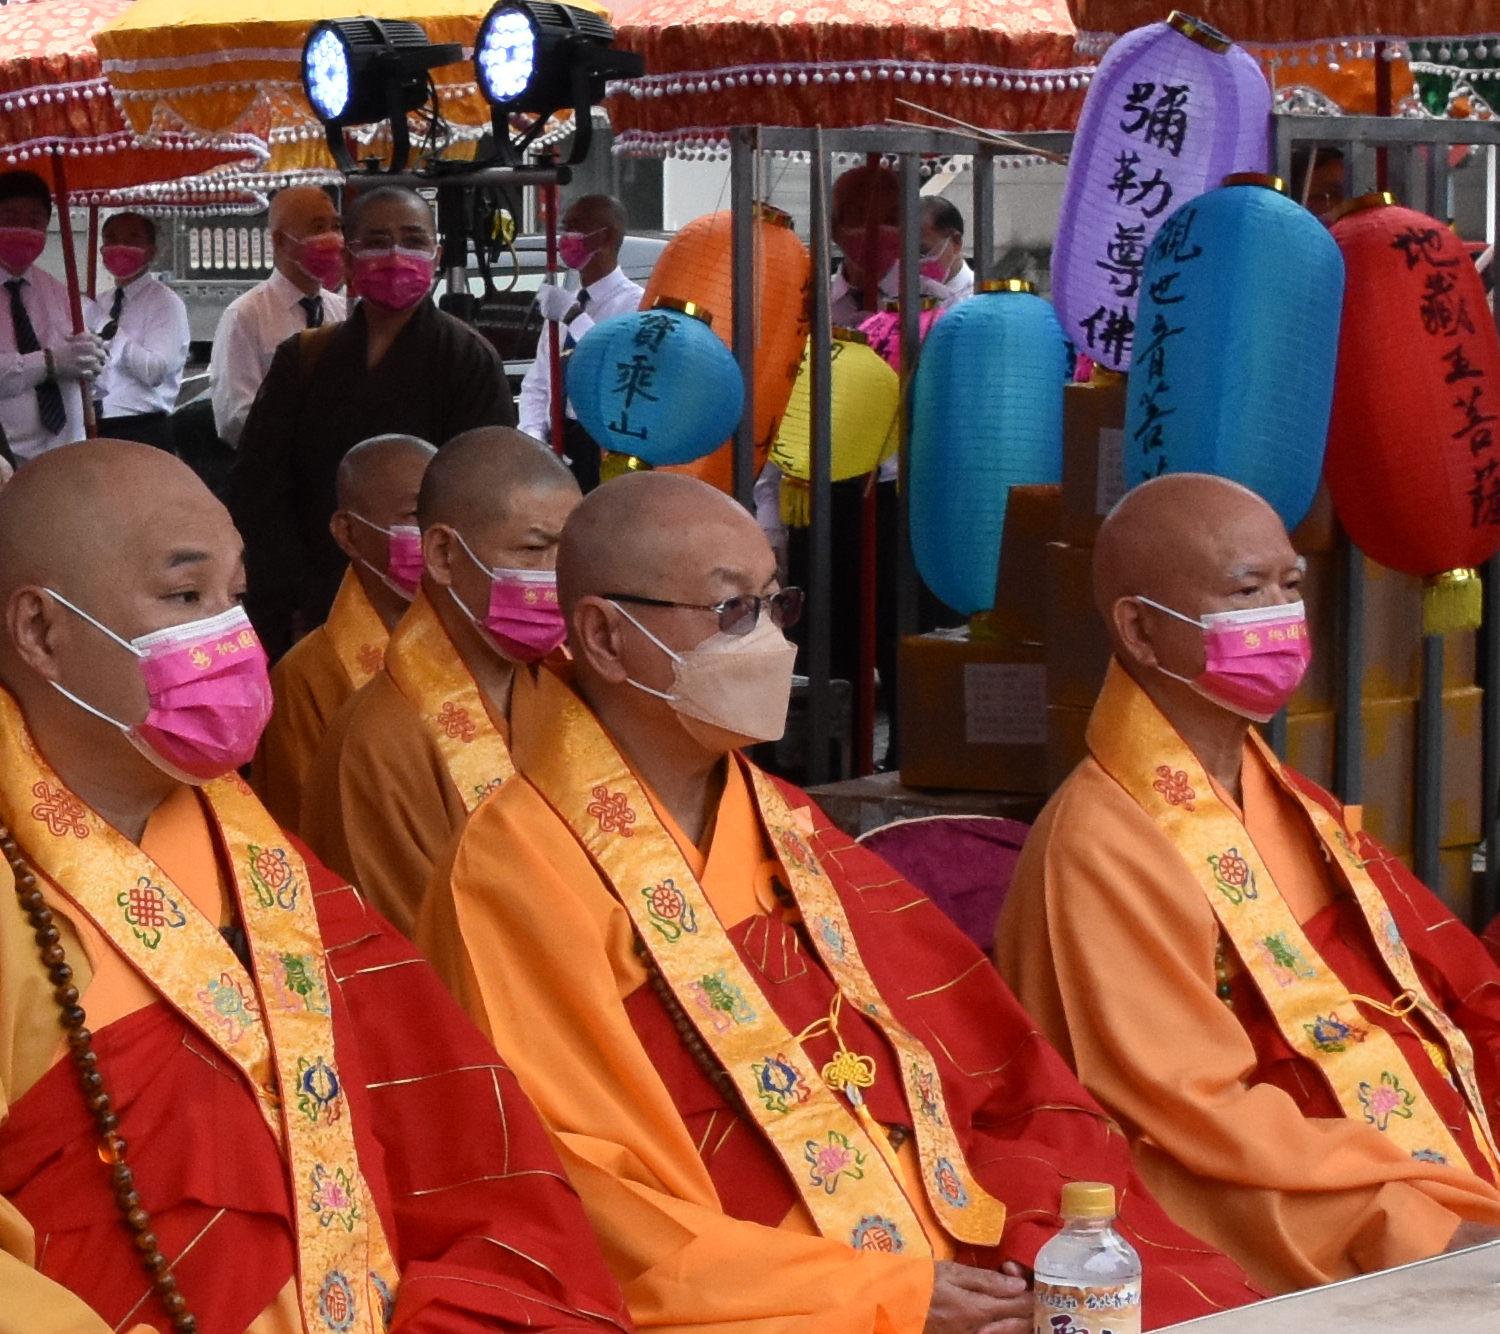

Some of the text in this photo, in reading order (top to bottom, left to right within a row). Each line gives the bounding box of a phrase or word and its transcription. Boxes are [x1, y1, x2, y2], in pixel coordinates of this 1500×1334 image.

[1079, 81, 1190, 366] 彌勒尊佛
[608, 313, 681, 441] 寶乘山
[1135, 207, 1203, 482] 觀世音菩
[217, 631, 255, 656] 桃園
